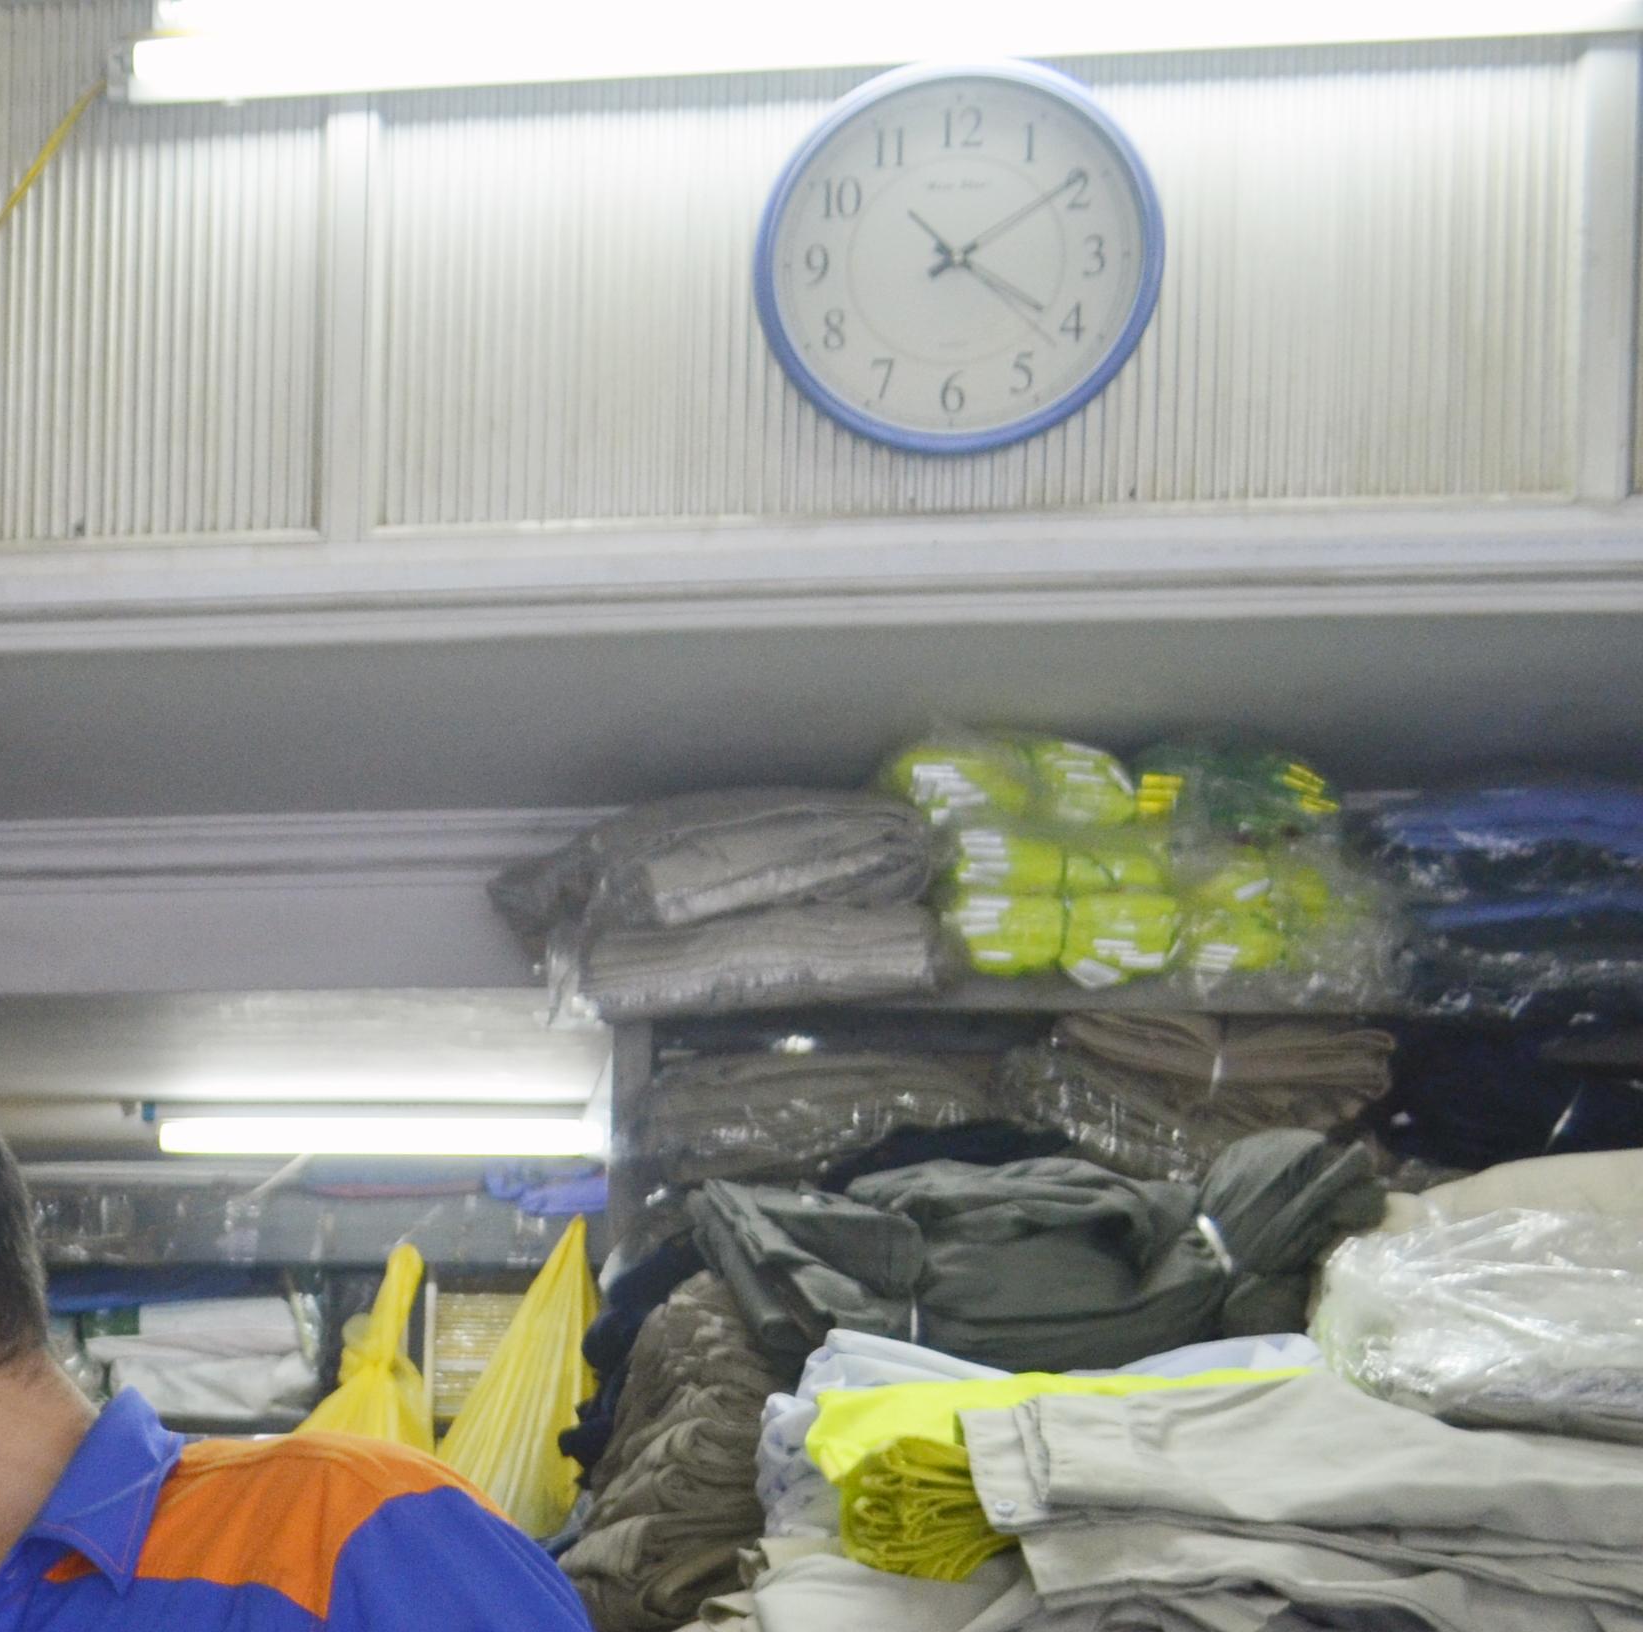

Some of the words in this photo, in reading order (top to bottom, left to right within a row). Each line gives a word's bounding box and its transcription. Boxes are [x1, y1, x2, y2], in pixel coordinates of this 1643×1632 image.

[875, 127, 905, 168] 11
[940, 106, 984, 148] 12
[1023, 122, 1035, 163] 1
[821, 176, 862, 219] 10
[1065, 169, 1091, 210] 2
[805, 243, 830, 287] 9
[1082, 234, 1107, 278] 3
[822, 308, 846, 351] 8
[1059, 302, 1085, 343] 4
[871, 357, 895, 400] 7
[940, 370, 965, 413] 6
[1010, 352, 1035, 394] 5
